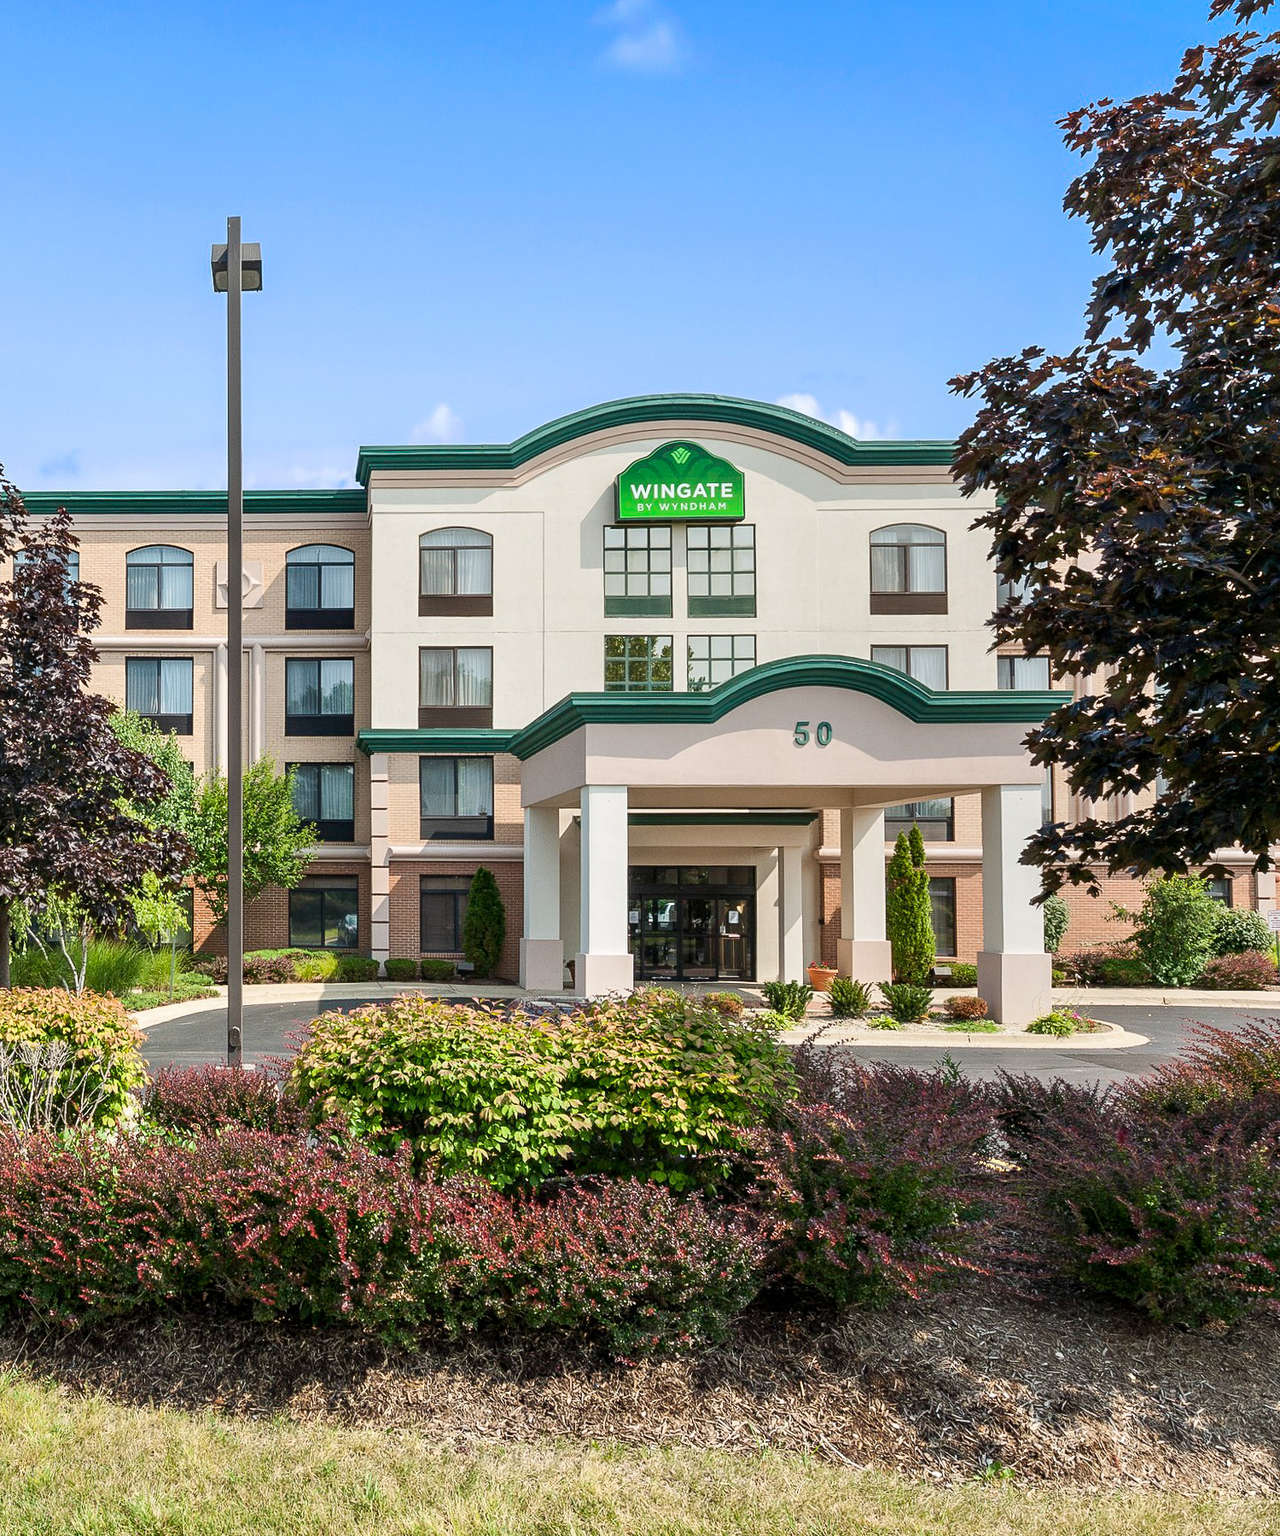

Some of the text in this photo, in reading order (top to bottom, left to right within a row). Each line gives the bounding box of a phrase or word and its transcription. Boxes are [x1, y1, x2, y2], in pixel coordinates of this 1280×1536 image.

[631, 483, 733, 499] WINGATE
[637, 502, 727, 512] BY WYNDHAM
[794, 721, 832, 746] 50
